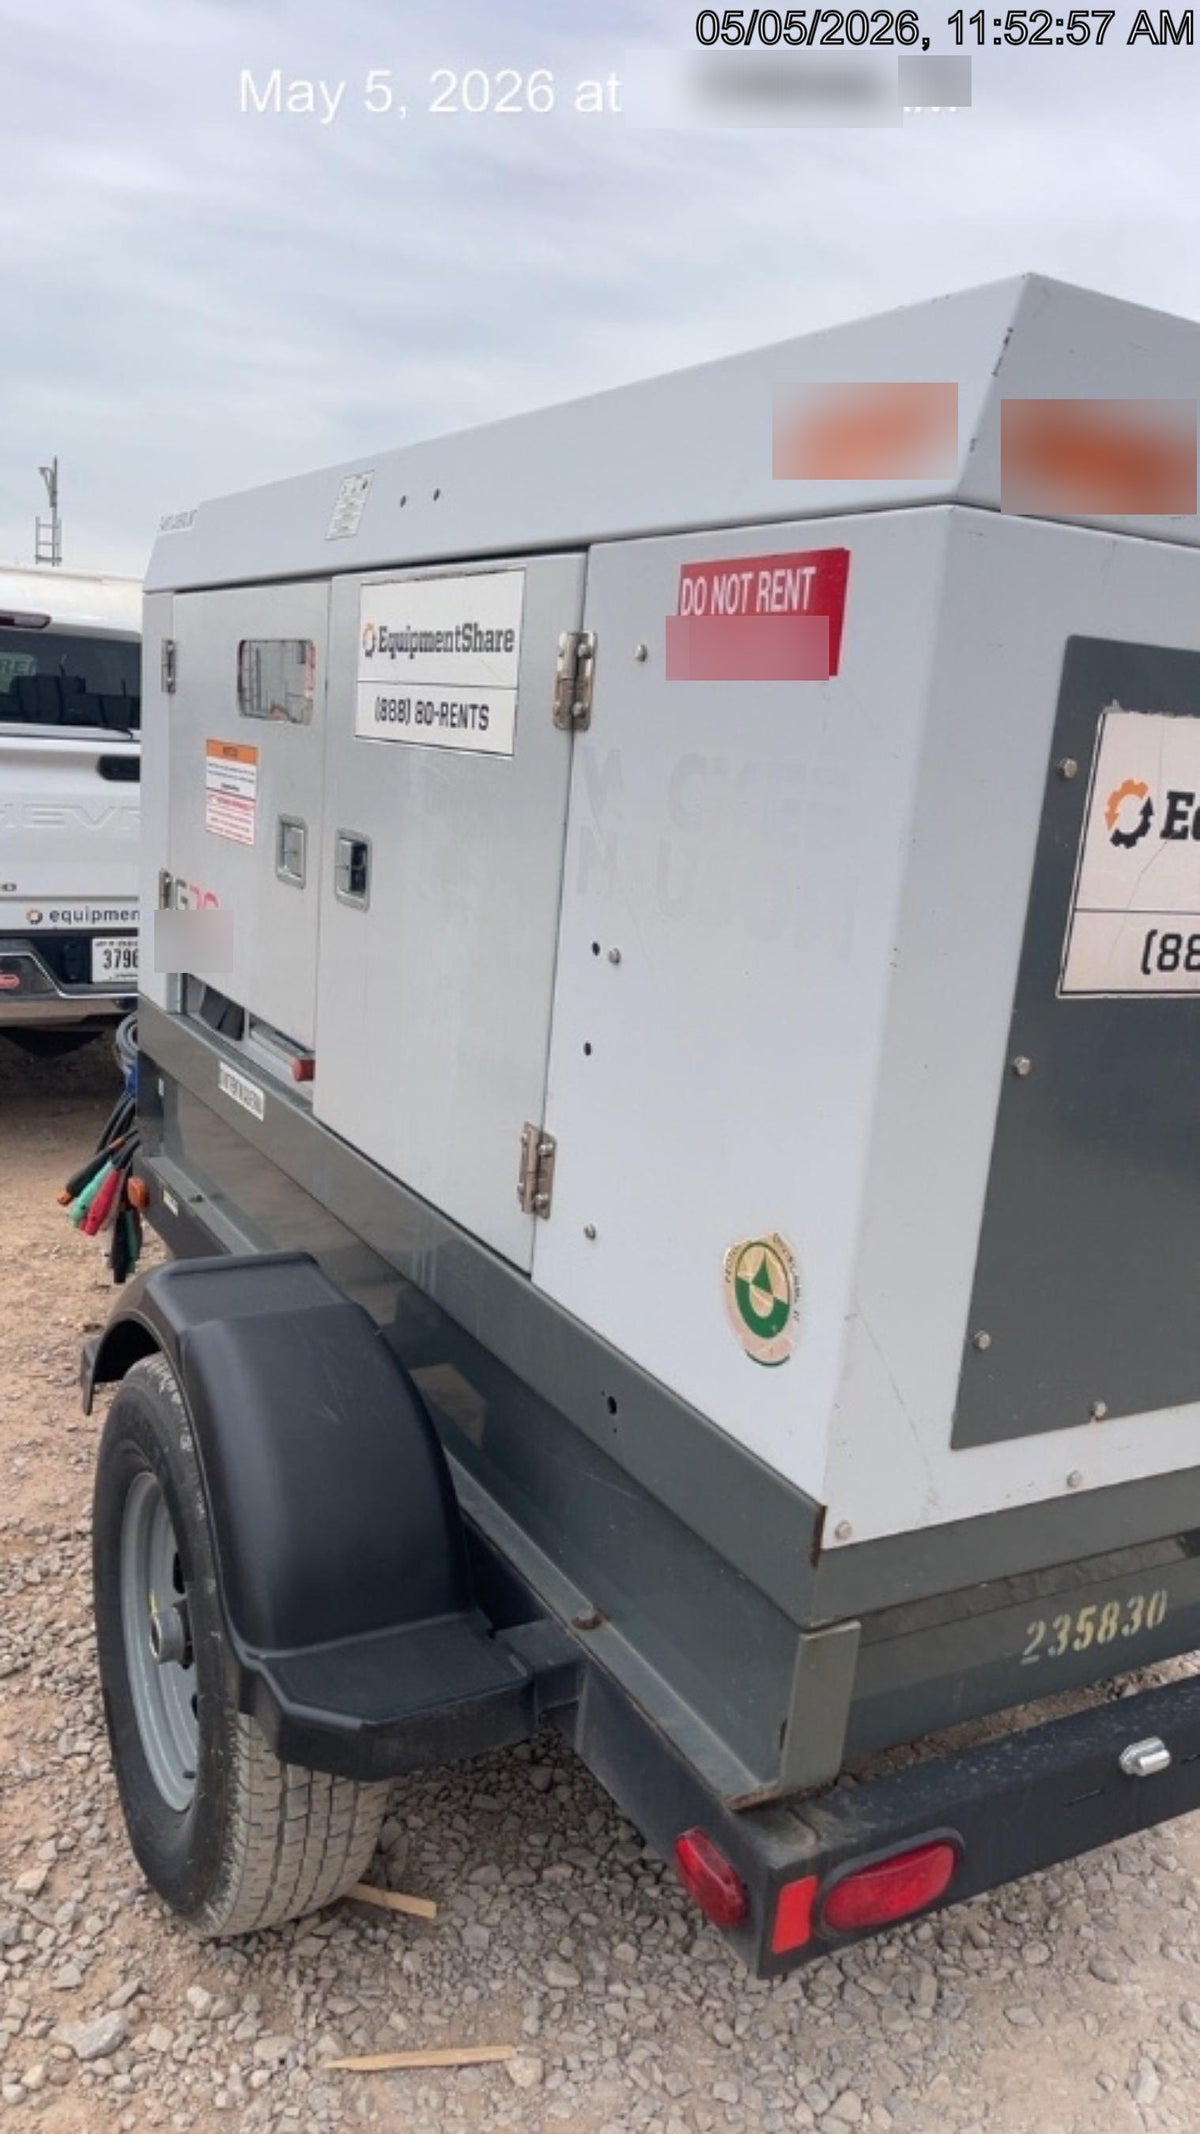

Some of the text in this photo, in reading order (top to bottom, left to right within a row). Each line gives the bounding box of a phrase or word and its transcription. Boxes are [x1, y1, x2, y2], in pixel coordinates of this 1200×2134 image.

[679, 565, 817, 616] DO NOT RENT
[378, 622, 516, 660] EquipmentShare
[374, 696, 490, 731] (888) 80-RENTS
[1159, 789, 1200, 840] E
[1020, 1588, 1167, 1666] 235830
